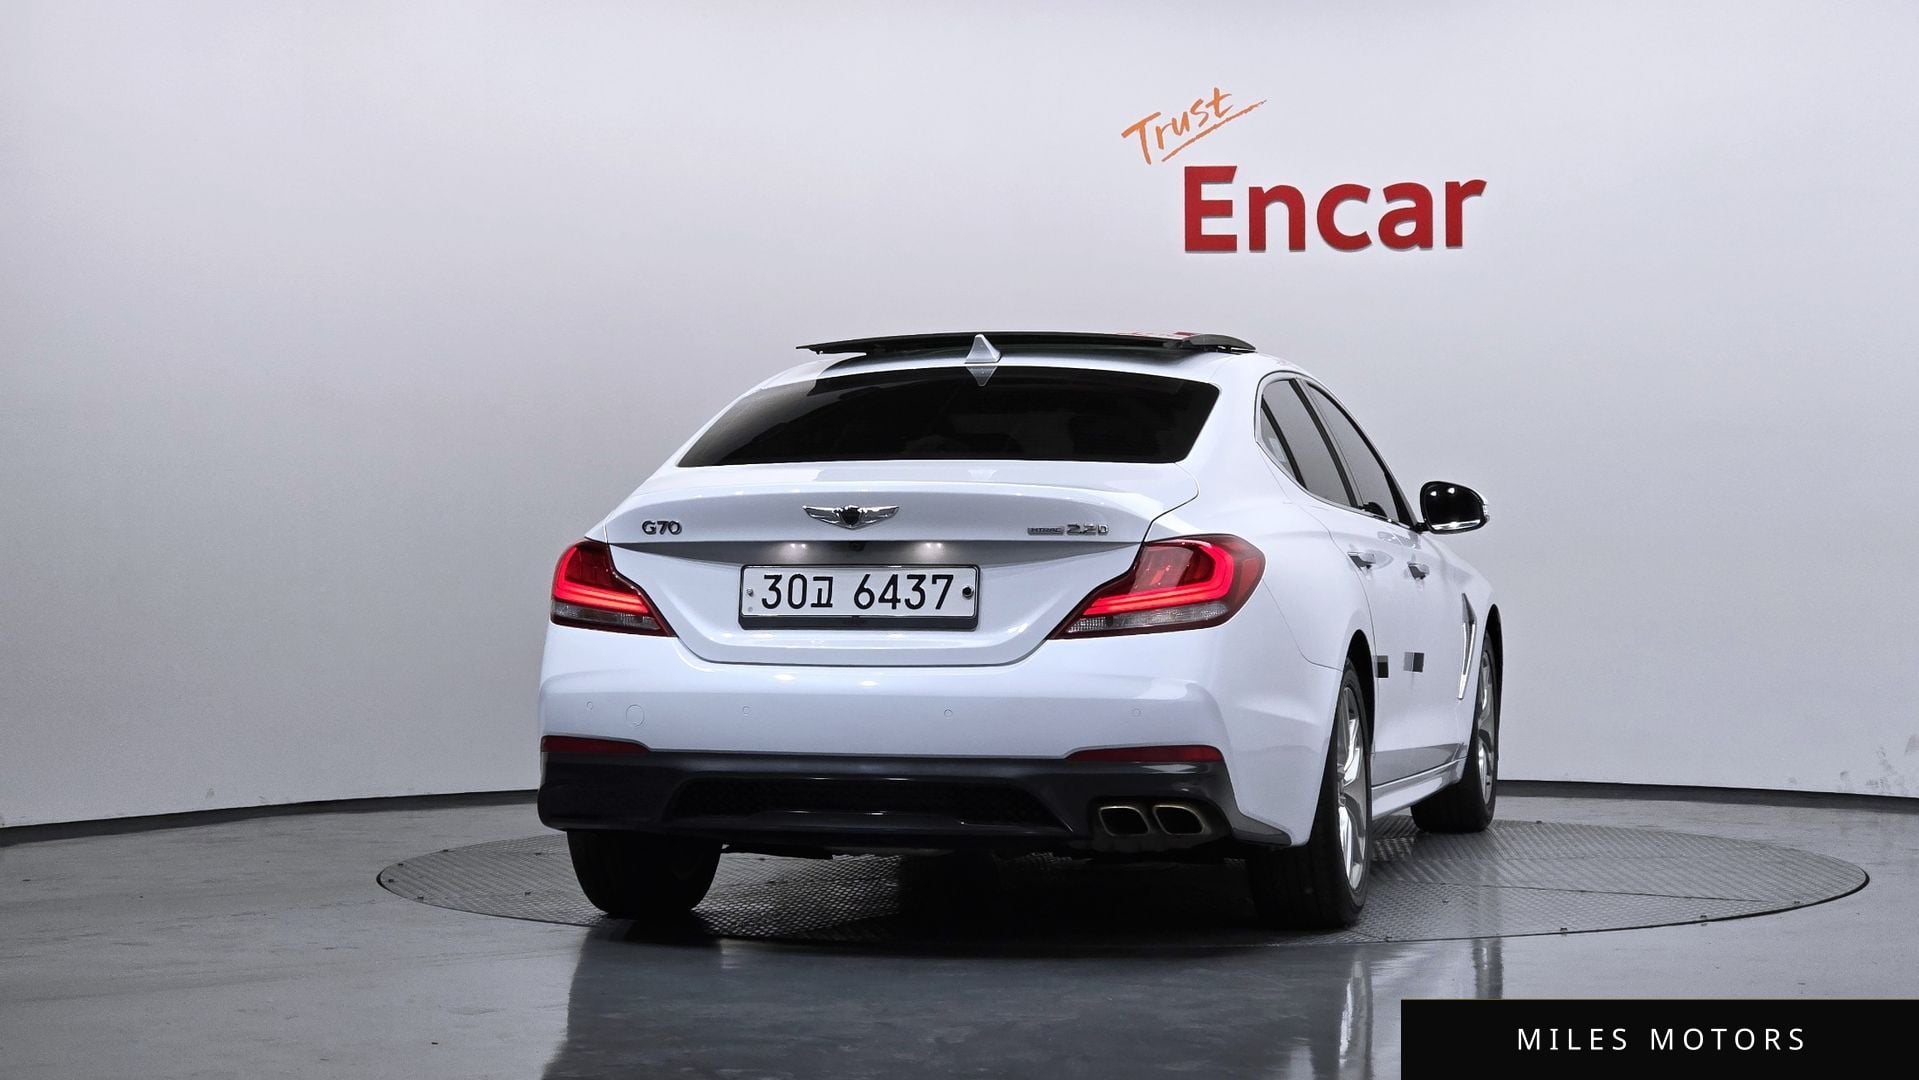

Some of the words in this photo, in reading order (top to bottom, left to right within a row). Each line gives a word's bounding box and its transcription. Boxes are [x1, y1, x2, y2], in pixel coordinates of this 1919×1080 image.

[1121, 87, 1234, 165] Trust
[1184, 165, 1488, 252] Encar
[641, 520, 683, 536] G70
[761, 573, 834, 610] 30고
[853, 573, 954, 610] 6437
